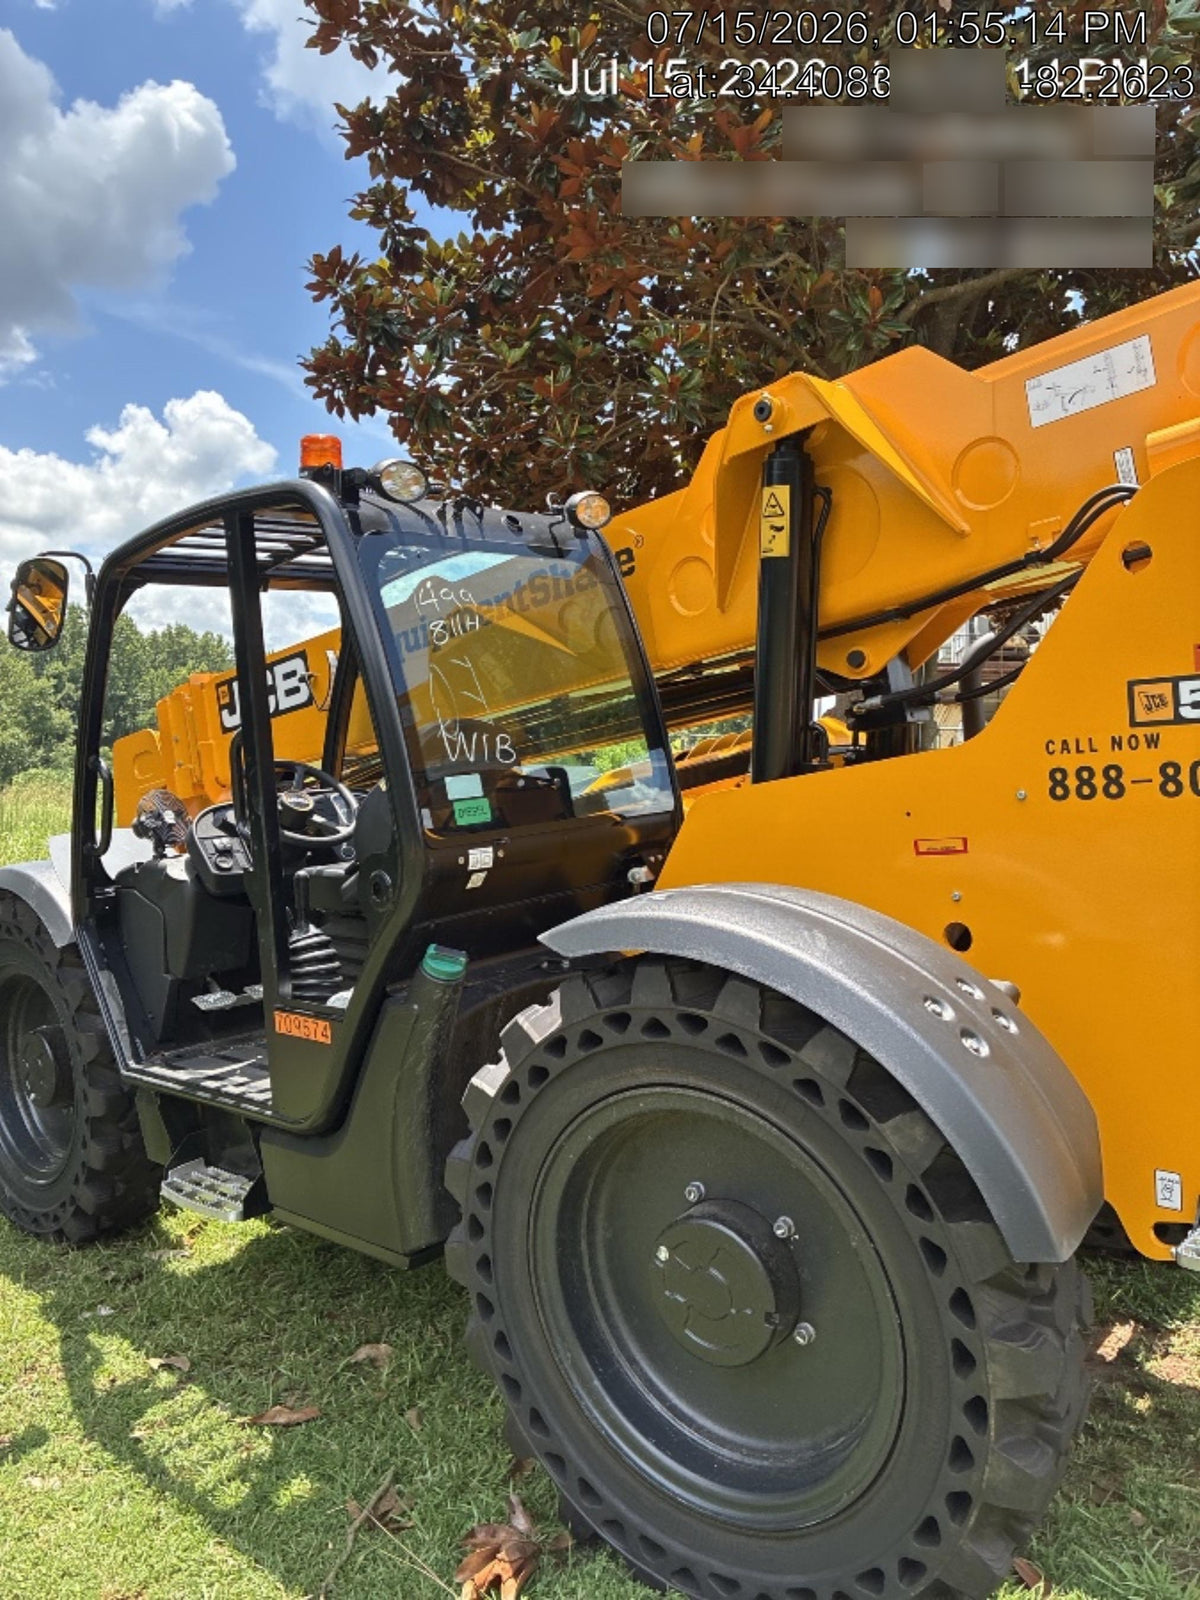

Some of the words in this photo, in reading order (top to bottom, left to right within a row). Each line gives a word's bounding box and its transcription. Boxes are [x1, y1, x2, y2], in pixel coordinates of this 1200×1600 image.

[1045, 737, 1098, 755] CALL
[1110, 732, 1161, 751] NOW
[276, 1013, 330, 1040] 709574
